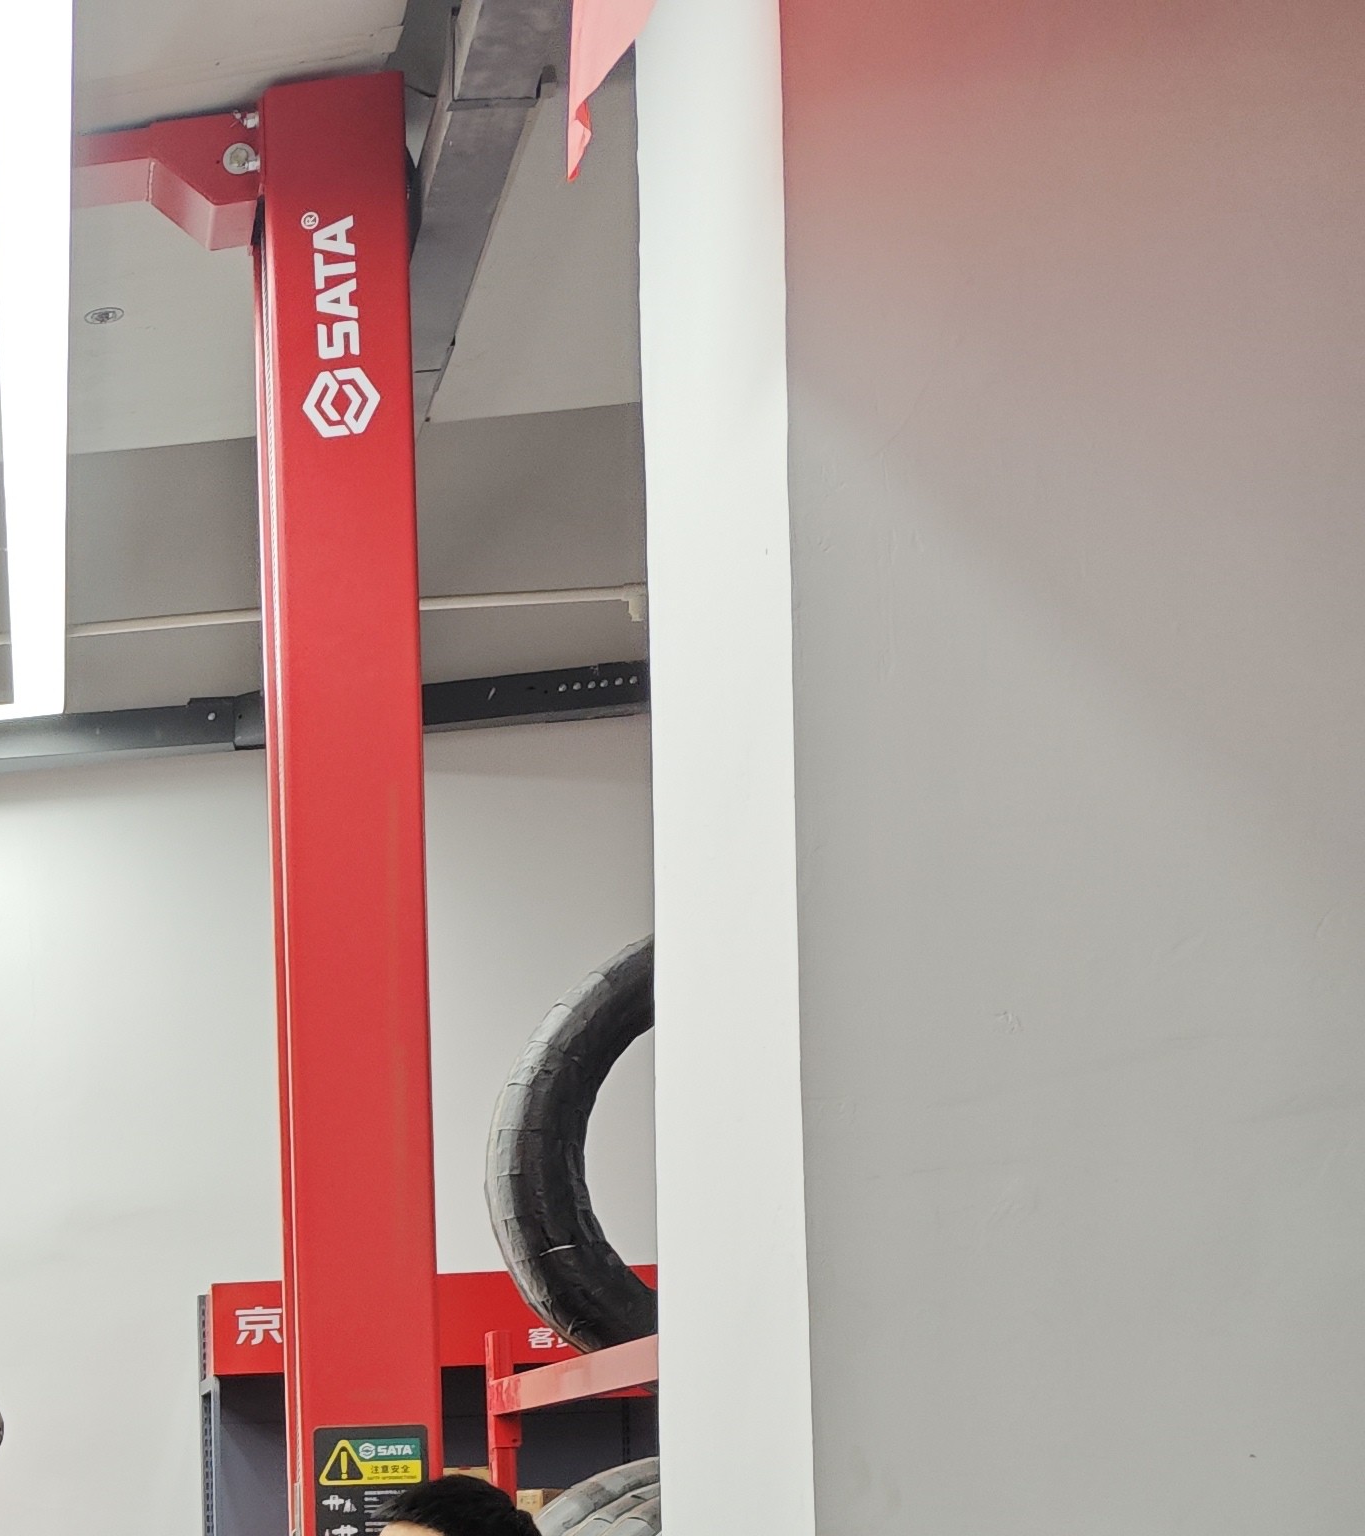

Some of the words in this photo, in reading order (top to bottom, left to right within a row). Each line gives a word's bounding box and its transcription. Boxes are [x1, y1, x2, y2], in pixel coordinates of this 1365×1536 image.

[312, 214, 360, 361] SATA
[527, 1326, 569, 1349] 客
[377, 1444, 413, 1457] SATA
[370, 1464, 411, 1475] 注意安全
